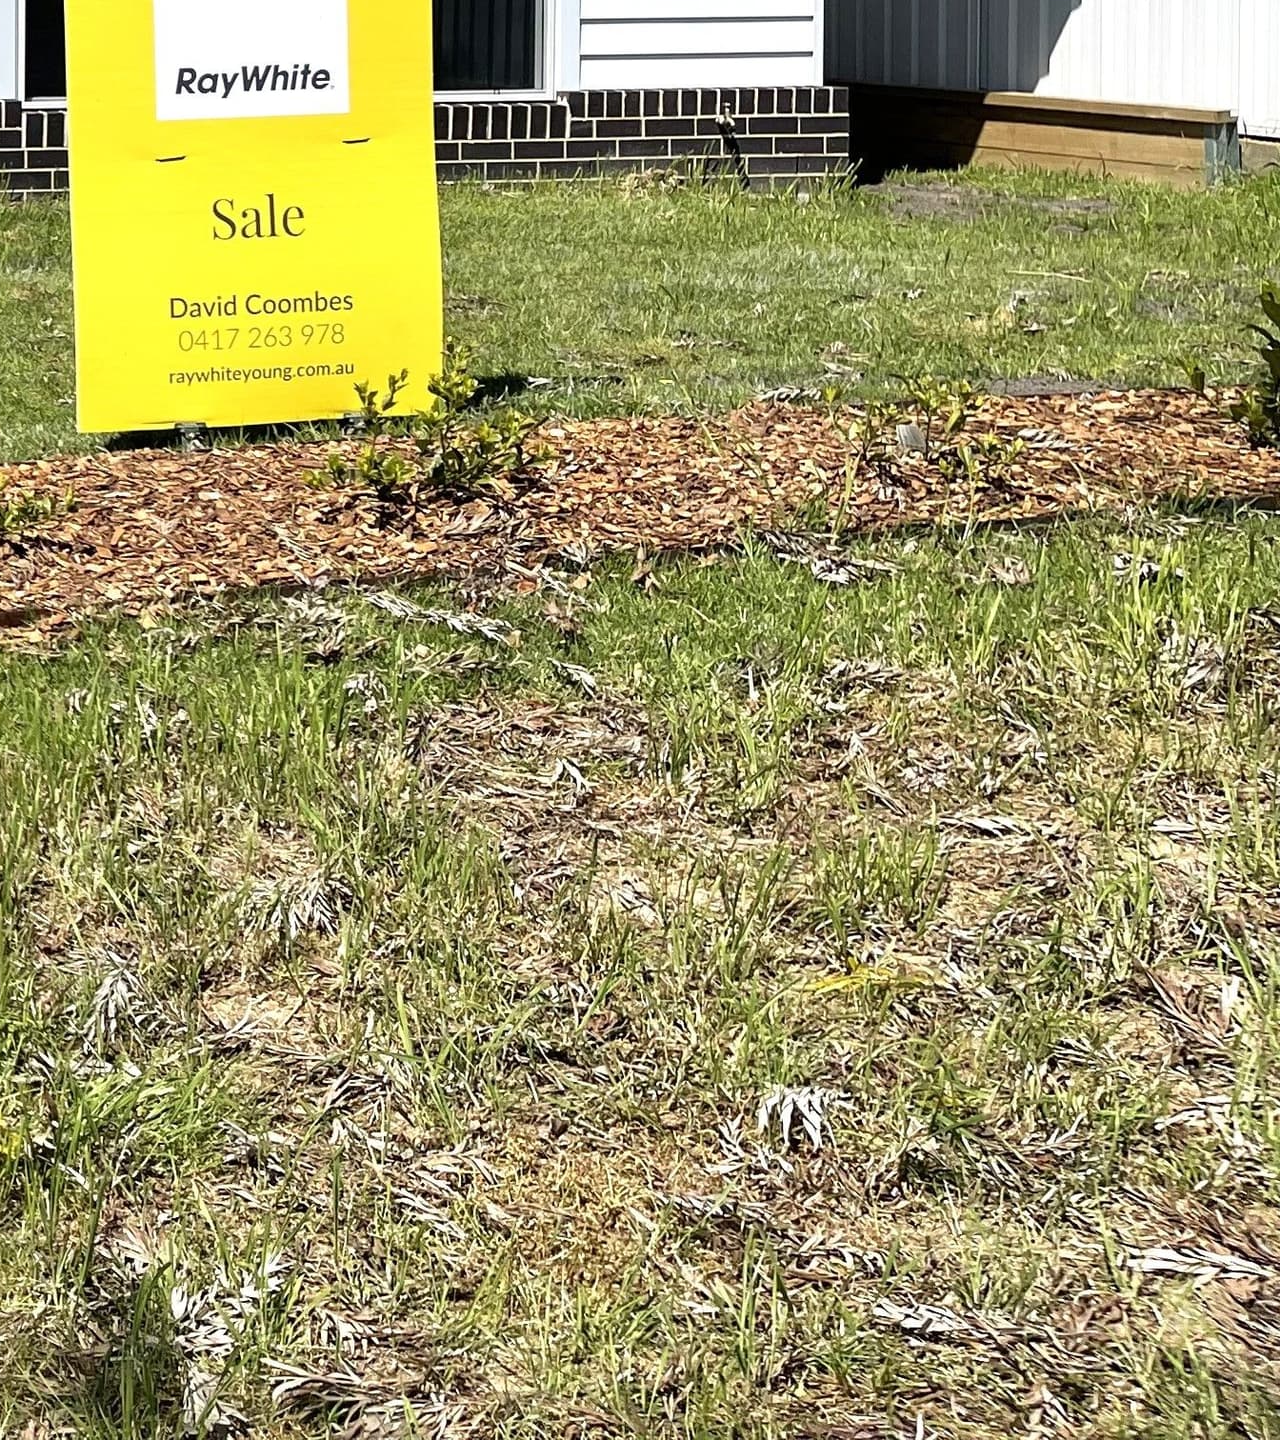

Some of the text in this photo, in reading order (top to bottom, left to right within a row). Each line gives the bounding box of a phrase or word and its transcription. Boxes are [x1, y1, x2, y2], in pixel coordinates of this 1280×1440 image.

[212, 193, 306, 240] Sale
[169, 291, 353, 318] David Coombes
[178, 323, 345, 352] 0417 263 978
[169, 363, 355, 386] raywhiteyoung.com.au
